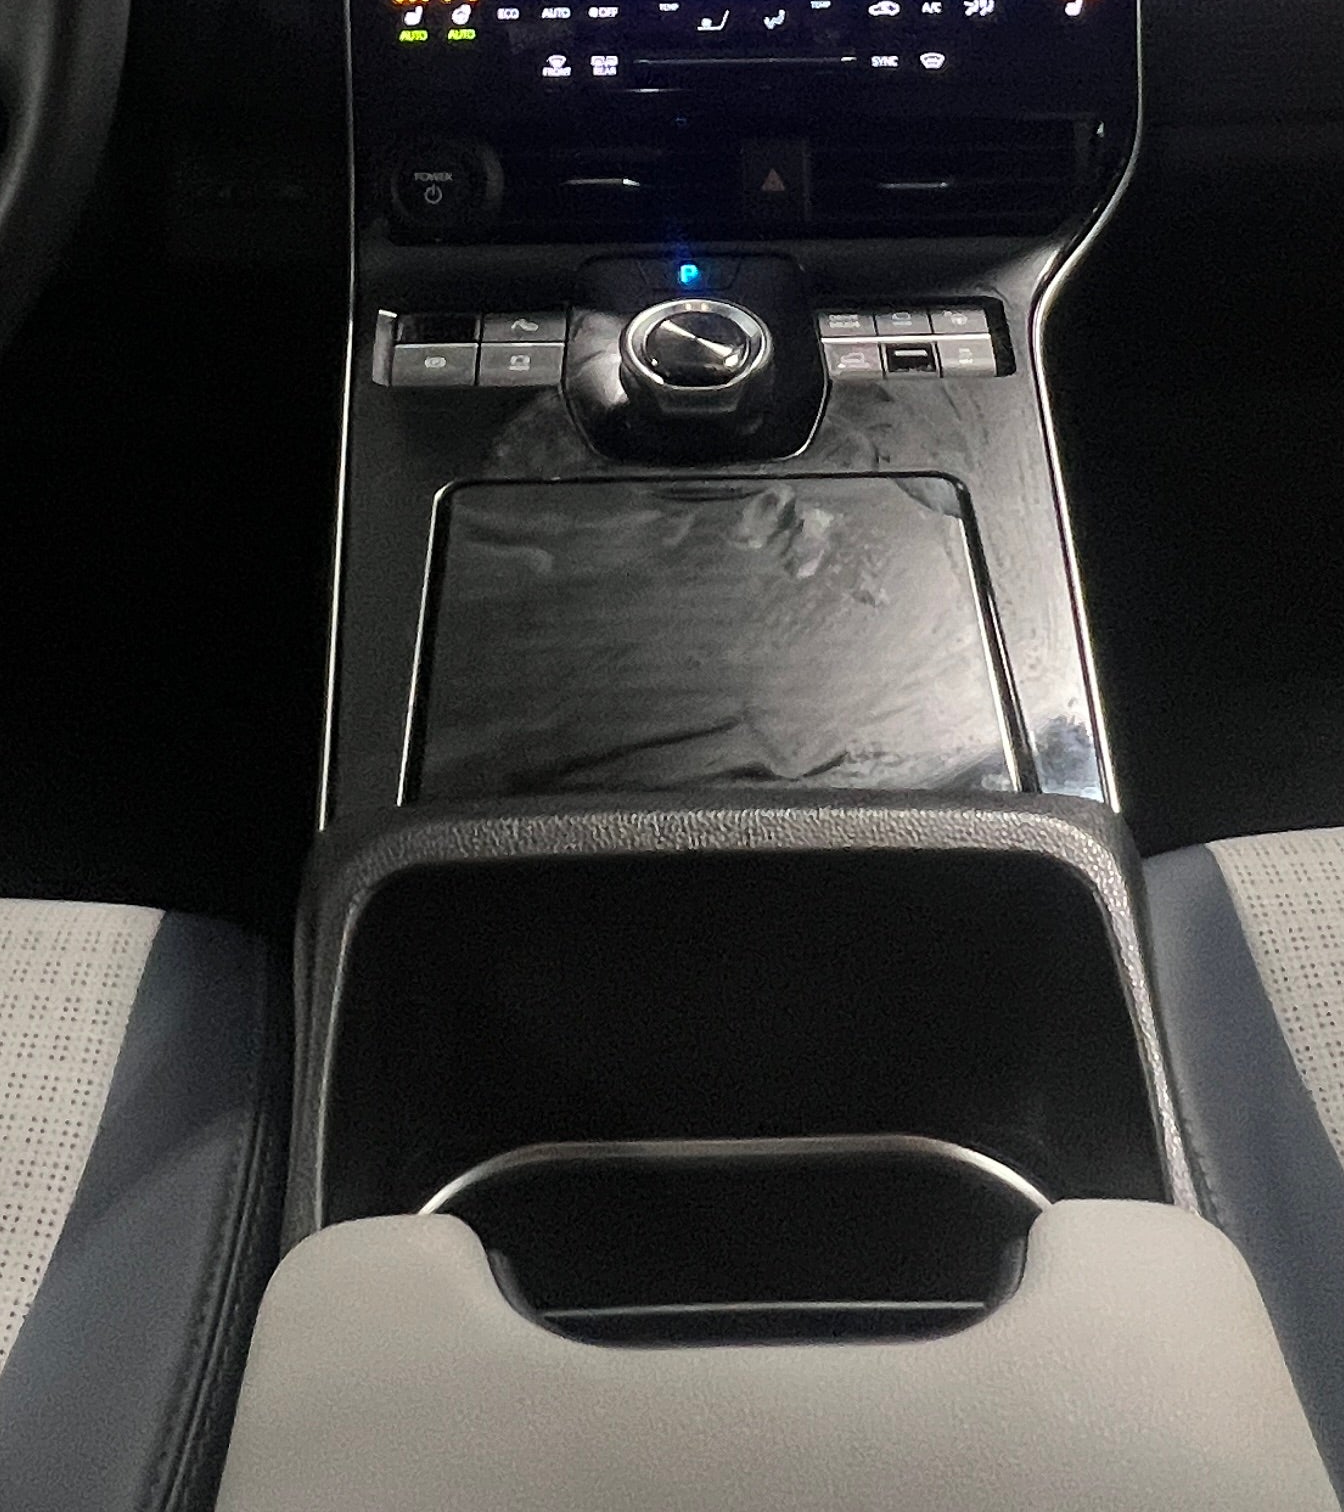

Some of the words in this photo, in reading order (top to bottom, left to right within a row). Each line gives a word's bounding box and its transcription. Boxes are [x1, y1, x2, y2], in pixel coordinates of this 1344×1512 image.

[541, 7, 571, 19] AUTO
[922, 1, 942, 14] A/C
[399, 30, 428, 42] AUTO
[447, 29, 476, 40] AUTO
[871, 55, 899, 68] SYNC
[680, 264, 698, 283] P
